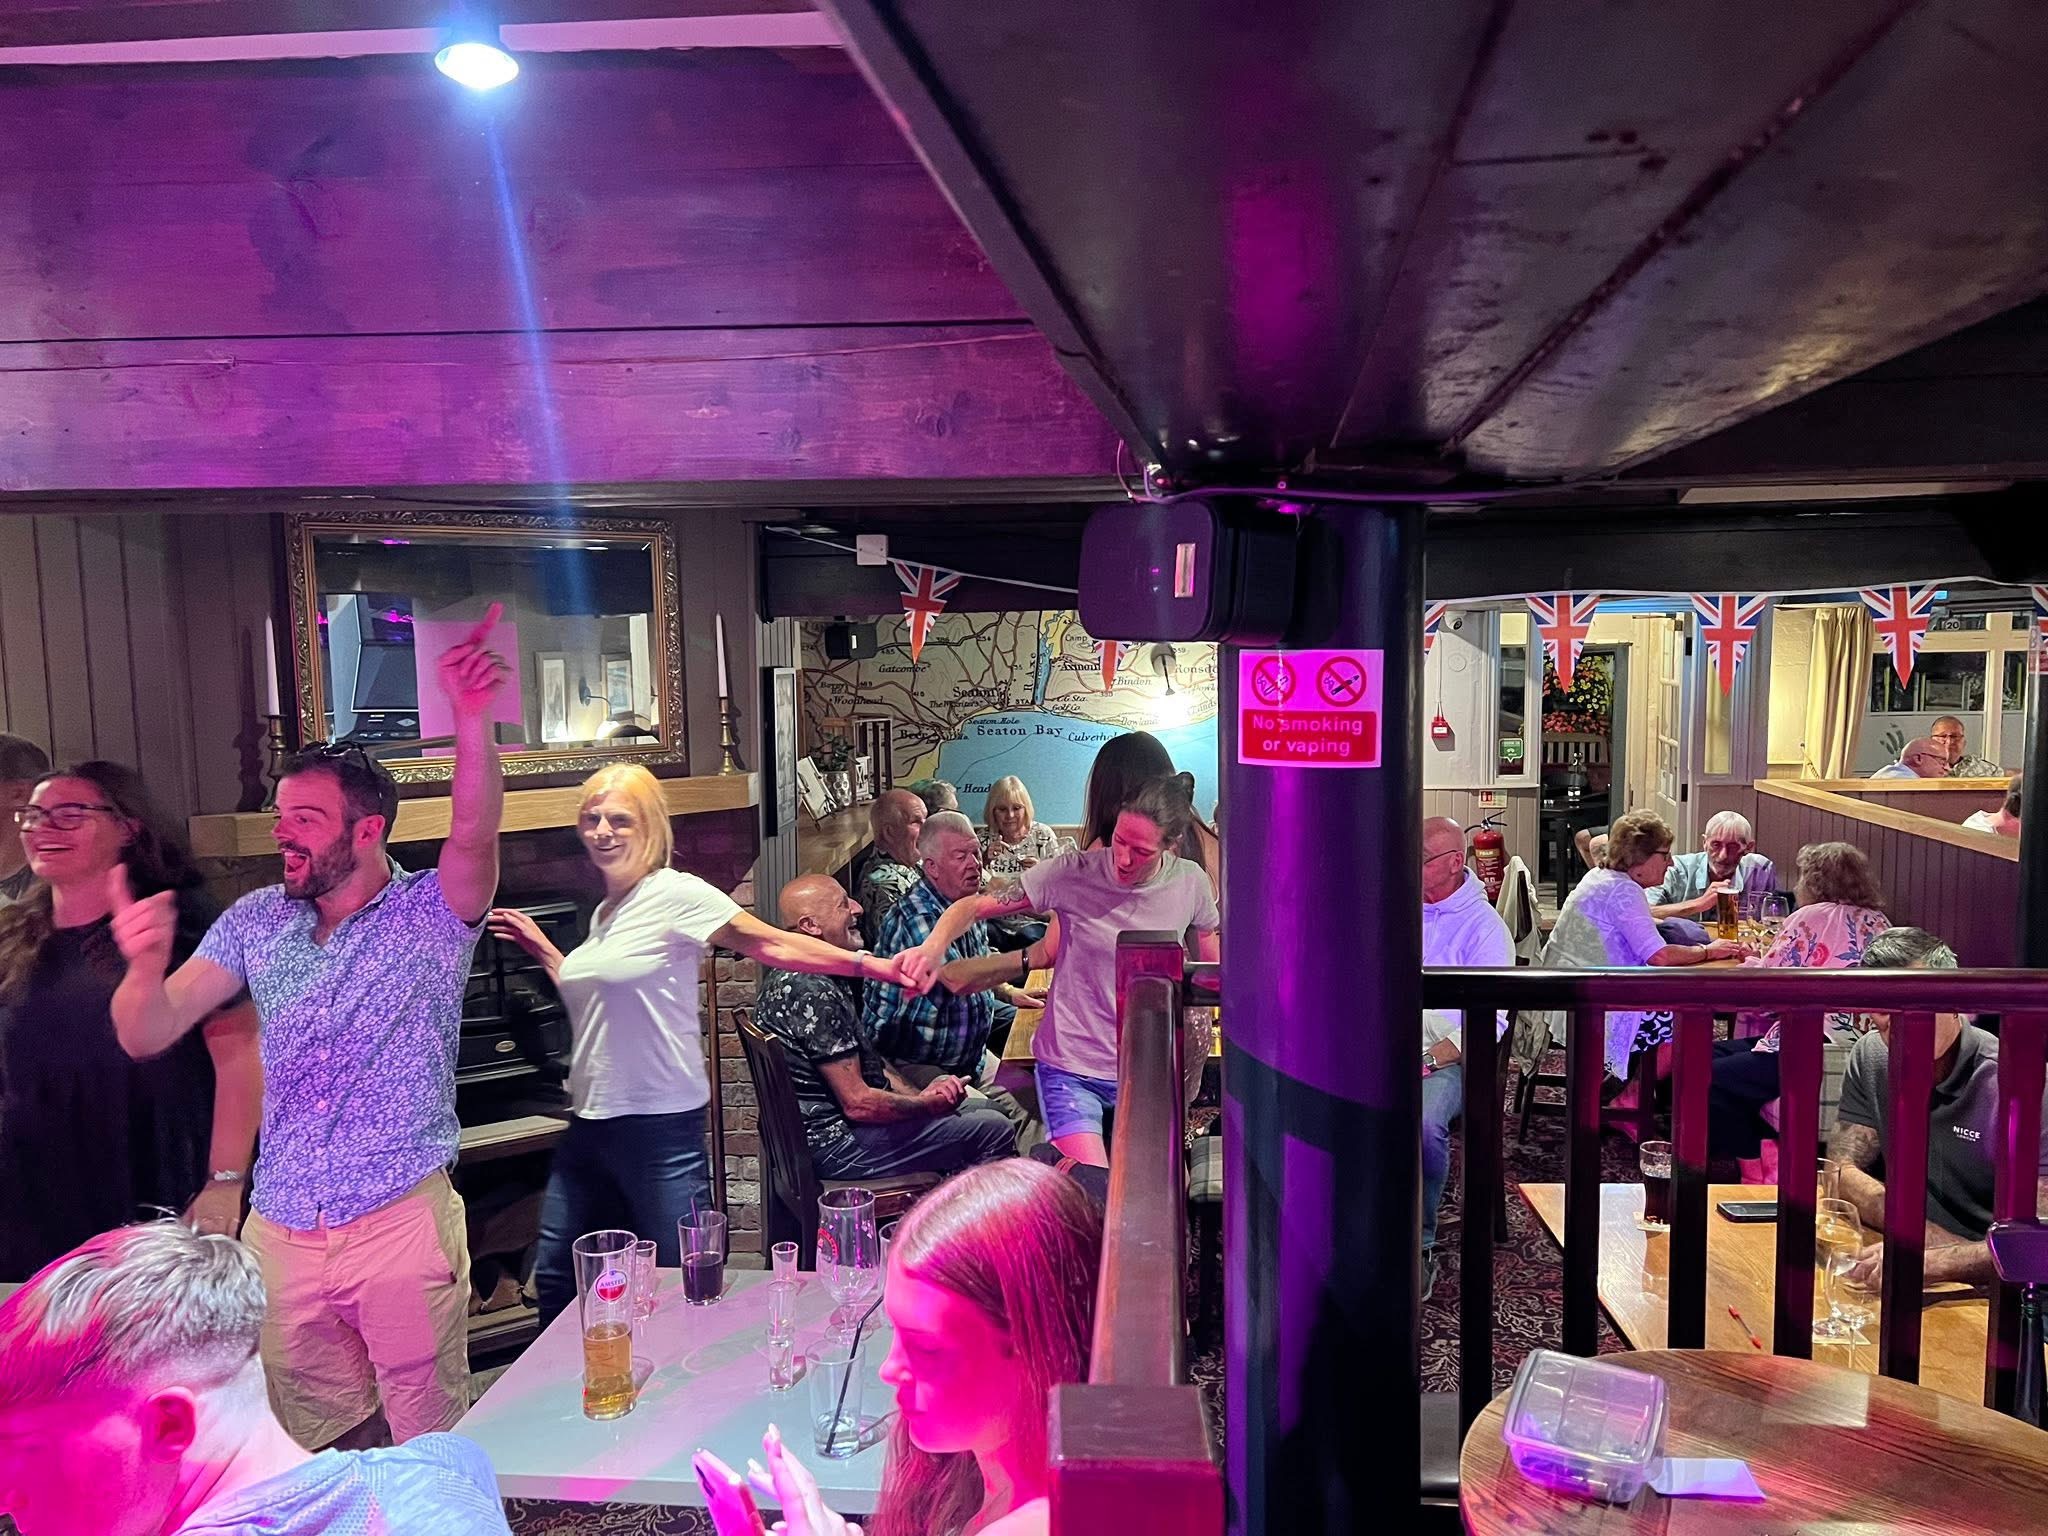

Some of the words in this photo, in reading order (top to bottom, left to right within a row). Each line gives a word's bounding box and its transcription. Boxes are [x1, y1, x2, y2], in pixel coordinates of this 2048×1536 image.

[1946, 621, 1959, 630] 20
[1065, 634, 1088, 642] Camp
[878, 664, 926, 673] Gatcombe
[1117, 676, 1150, 685] Binden
[952, 686, 996, 698] Seaton
[1253, 714, 1275, 730] No
[1280, 716, 1363, 735] smoking
[977, 725, 1027, 736] Seaton
[1034, 725, 1063, 737] Bay
[1262, 739, 1280, 751] or
[1287, 738, 1351, 757] vaping
[963, 783, 992, 793] Head
[1953, 1125, 1981, 1139] NICCE
